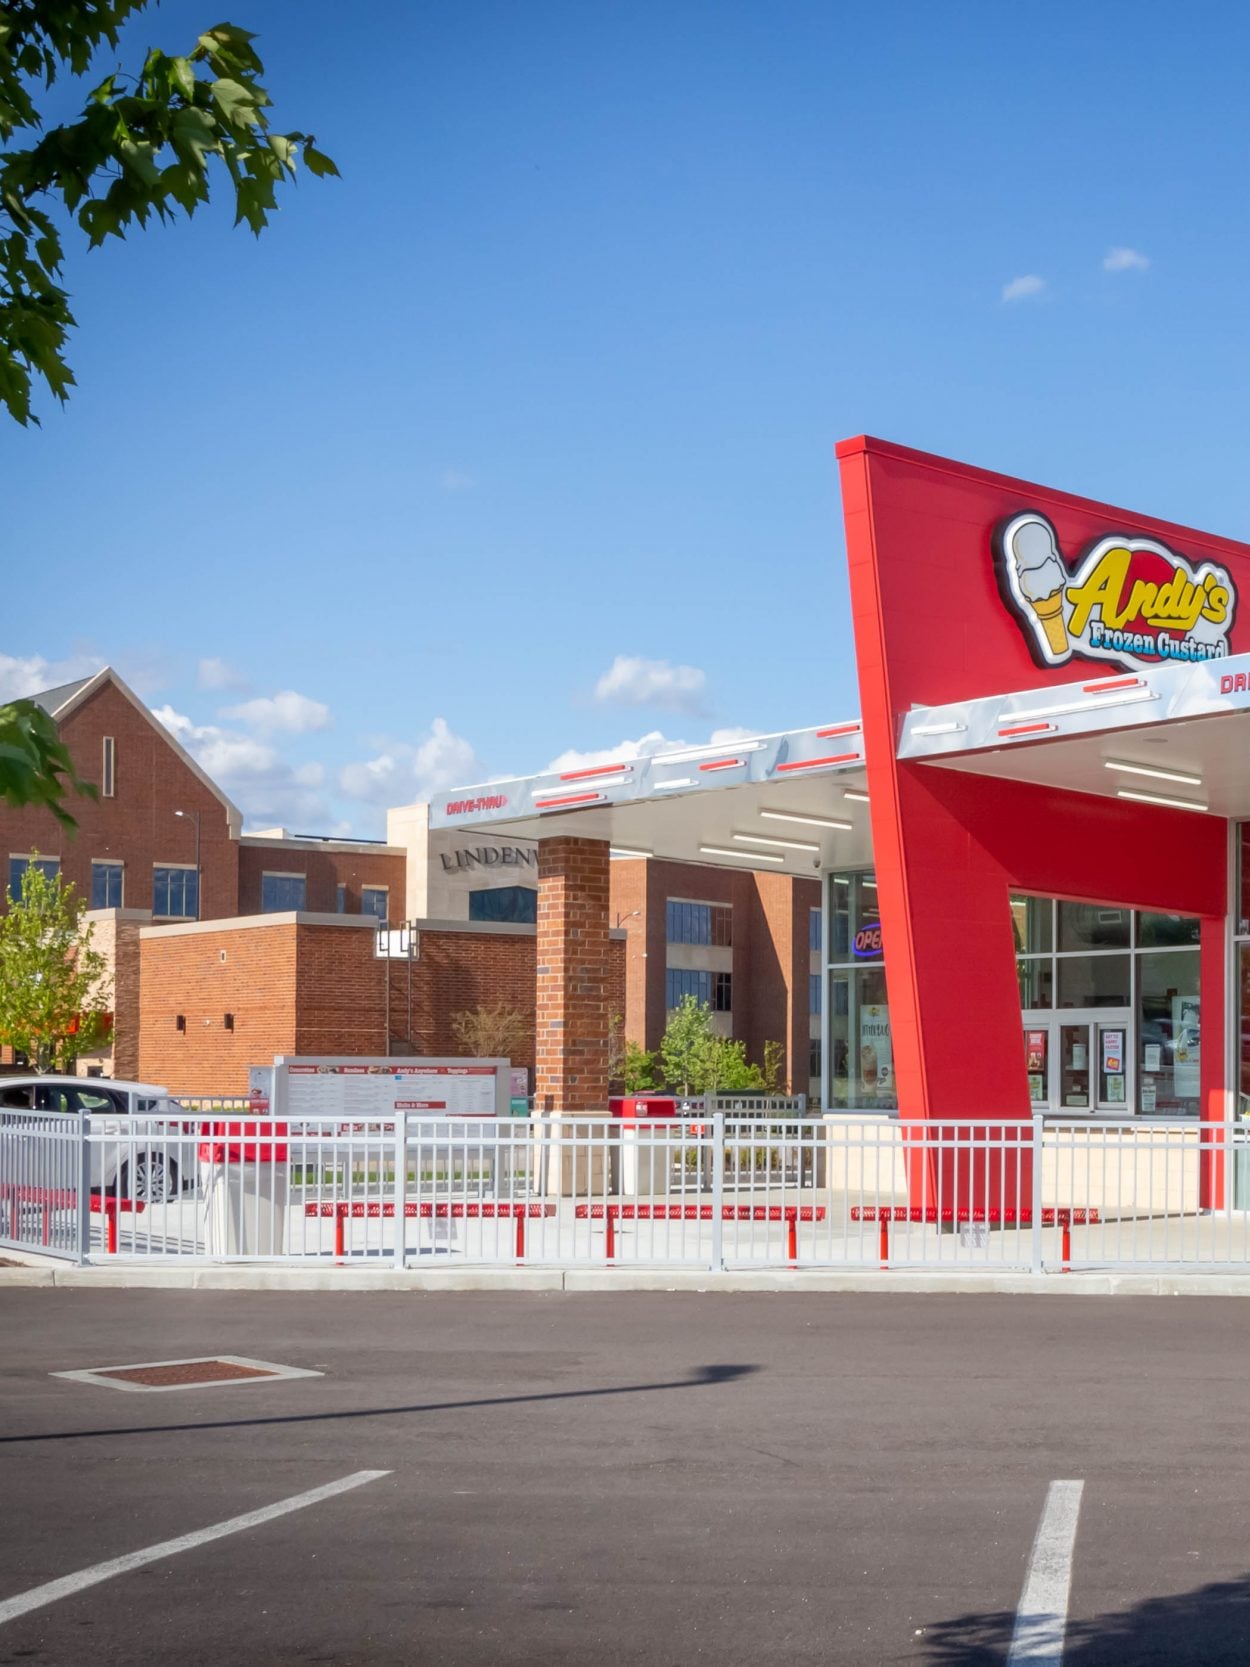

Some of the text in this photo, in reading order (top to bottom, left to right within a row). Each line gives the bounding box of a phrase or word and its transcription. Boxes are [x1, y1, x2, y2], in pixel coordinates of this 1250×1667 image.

[1066, 548, 1229, 638] Andy's
[1090, 621, 1226, 662] Frozen Custard
[446, 795, 502, 816] DRIVE-THRU
[439, 846, 538, 870] LINDEN
[855, 930, 882, 950] OPE
